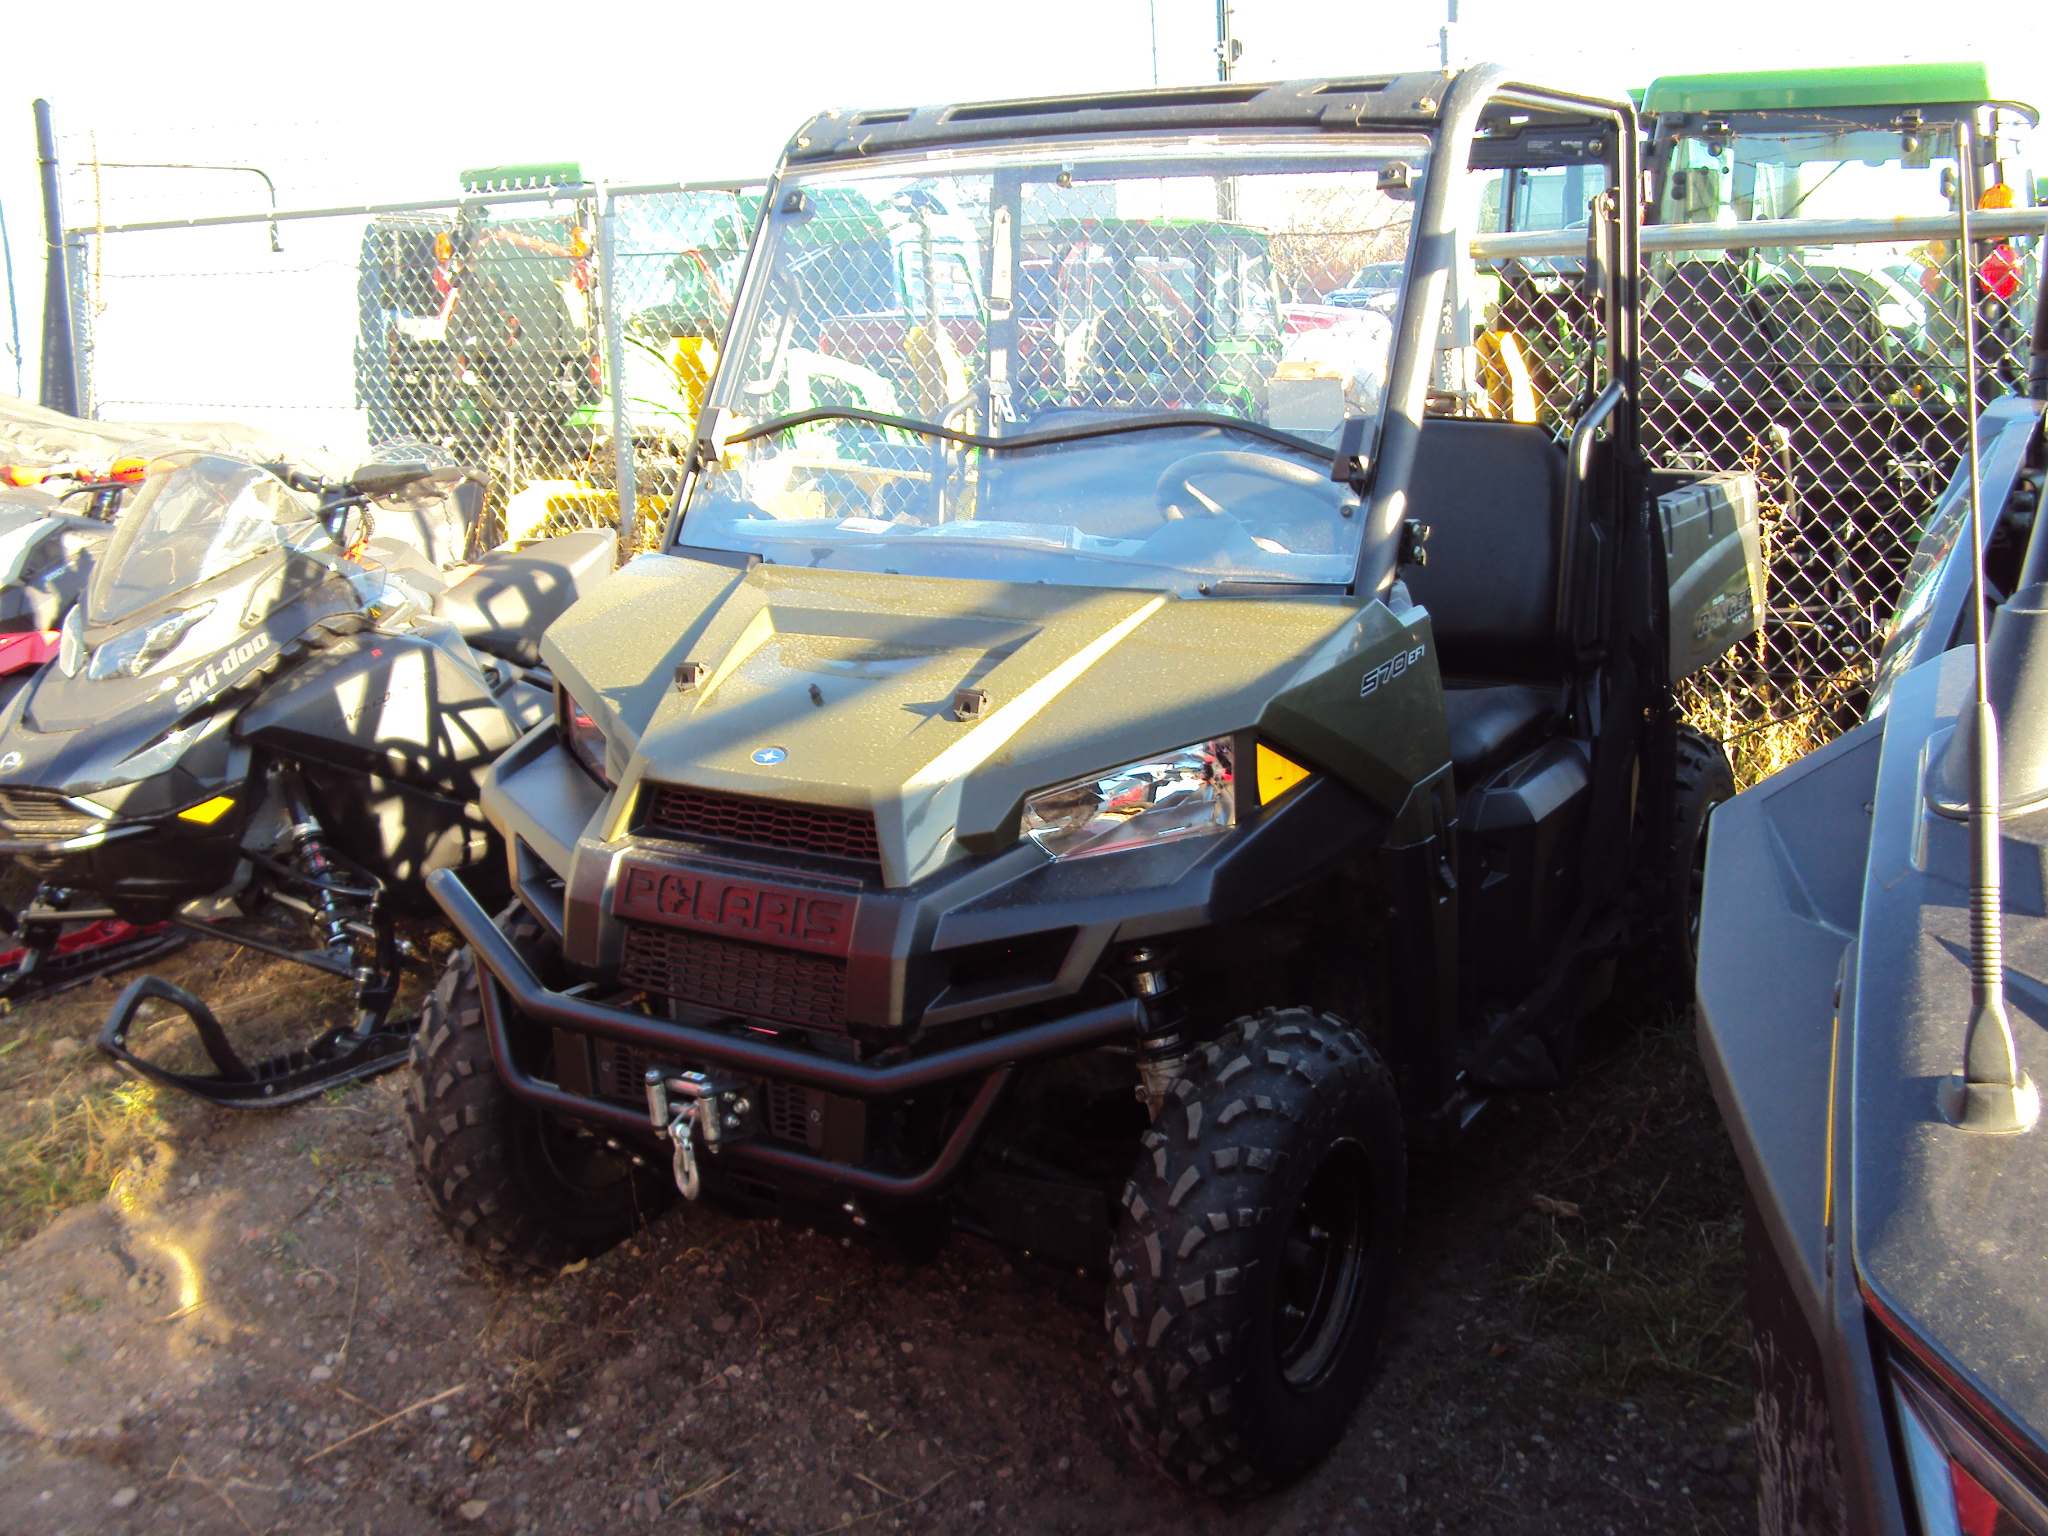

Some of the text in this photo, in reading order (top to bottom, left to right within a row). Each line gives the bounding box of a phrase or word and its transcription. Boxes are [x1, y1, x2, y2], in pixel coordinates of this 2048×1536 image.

[1360, 644, 1425, 697] 570 EFI
[624, 867, 843, 945] POLARIS
